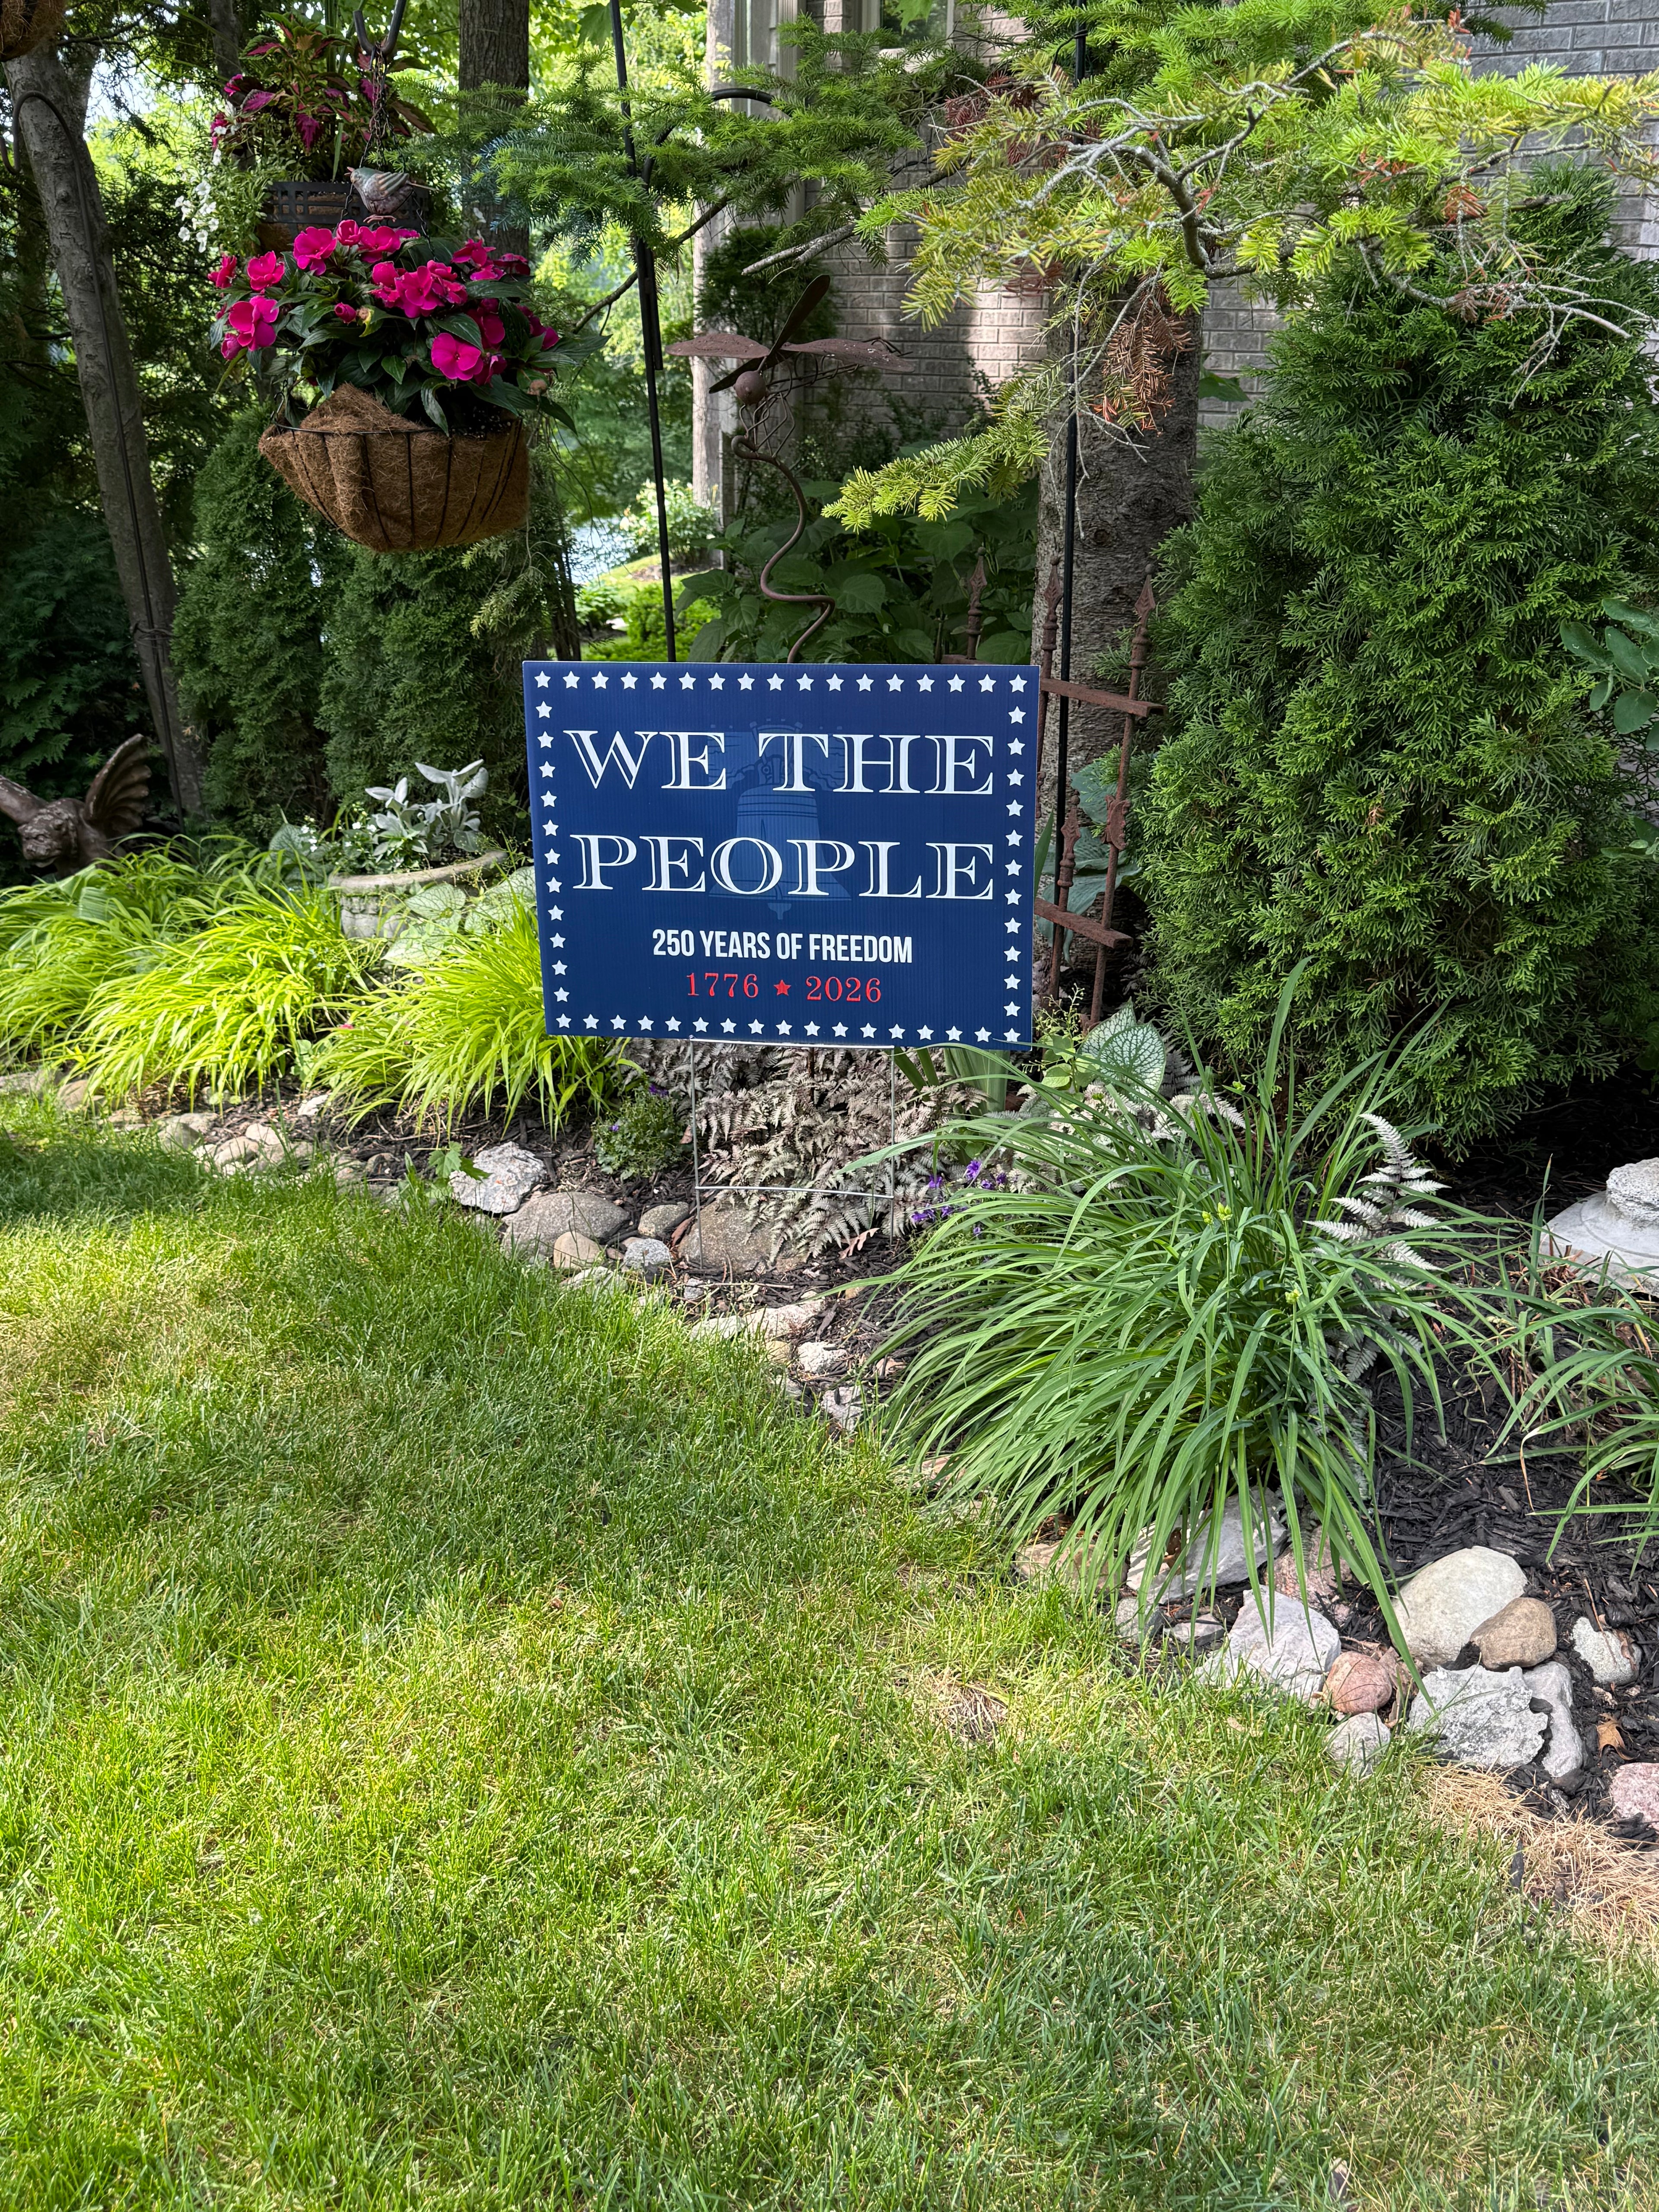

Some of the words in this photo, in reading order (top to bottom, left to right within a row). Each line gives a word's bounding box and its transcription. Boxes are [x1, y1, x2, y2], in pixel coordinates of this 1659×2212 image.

[563, 730, 727, 790] WE
[758, 732, 994, 795] THE
[569, 834, 993, 900] PEOPLE
[652, 928, 695, 957] 250
[699, 930, 771, 959] YEARS
[776, 932, 803, 960] OF
[809, 933, 912, 963] FREEDOM
[686, 972, 759, 998] 1776
[805, 976, 882, 1003] 2026
